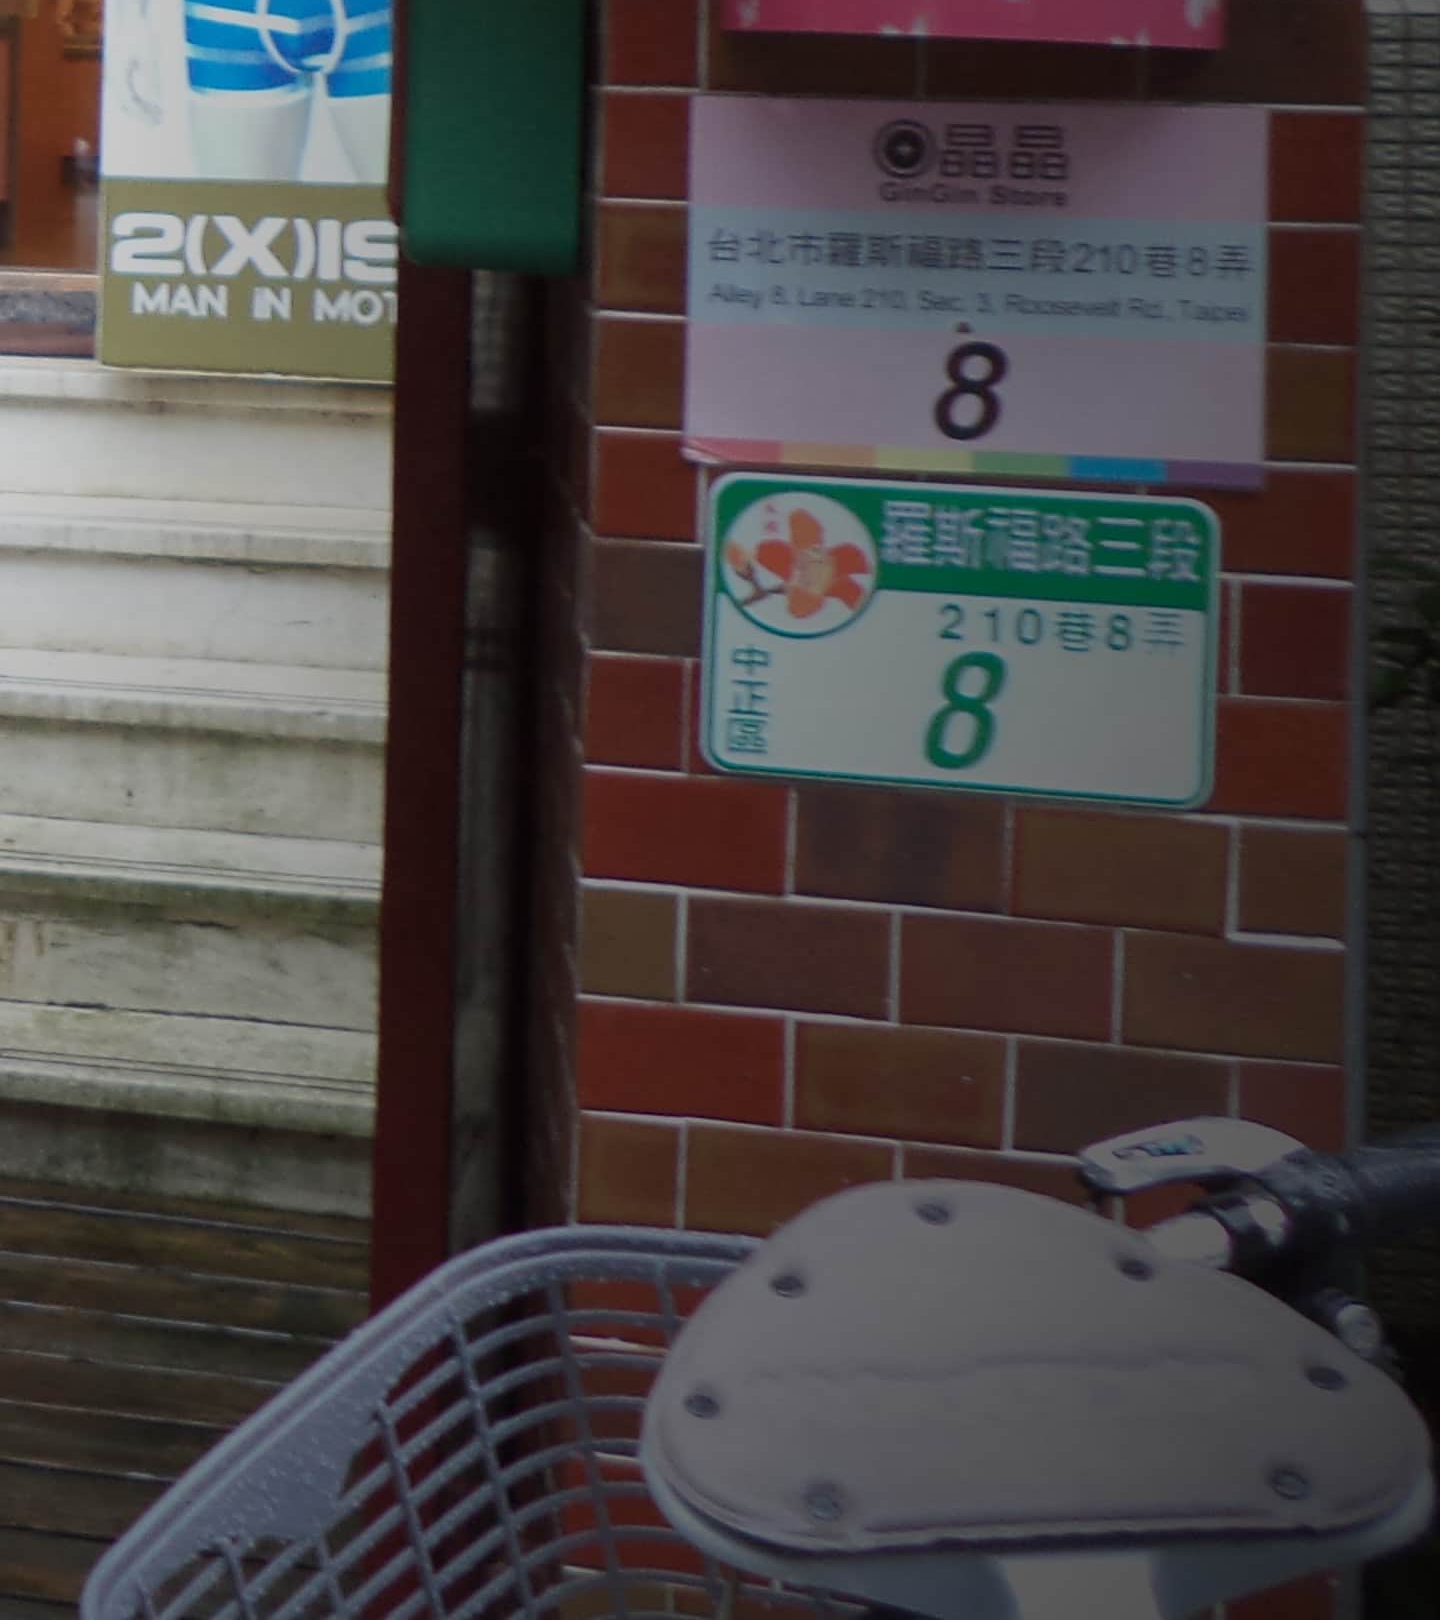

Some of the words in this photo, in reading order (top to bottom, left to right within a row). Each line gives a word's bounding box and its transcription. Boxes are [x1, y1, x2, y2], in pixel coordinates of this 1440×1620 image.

[939, 123, 1069, 179] 晶晶
[989, 184, 1069, 207] Store
[131, 283, 230, 318] MAN
[251, 287, 293, 321] IN
[933, 341, 1009, 441] 8
[879, 499, 1201, 582] 羅斯福路三段
[923, 650, 1007, 771] 8
